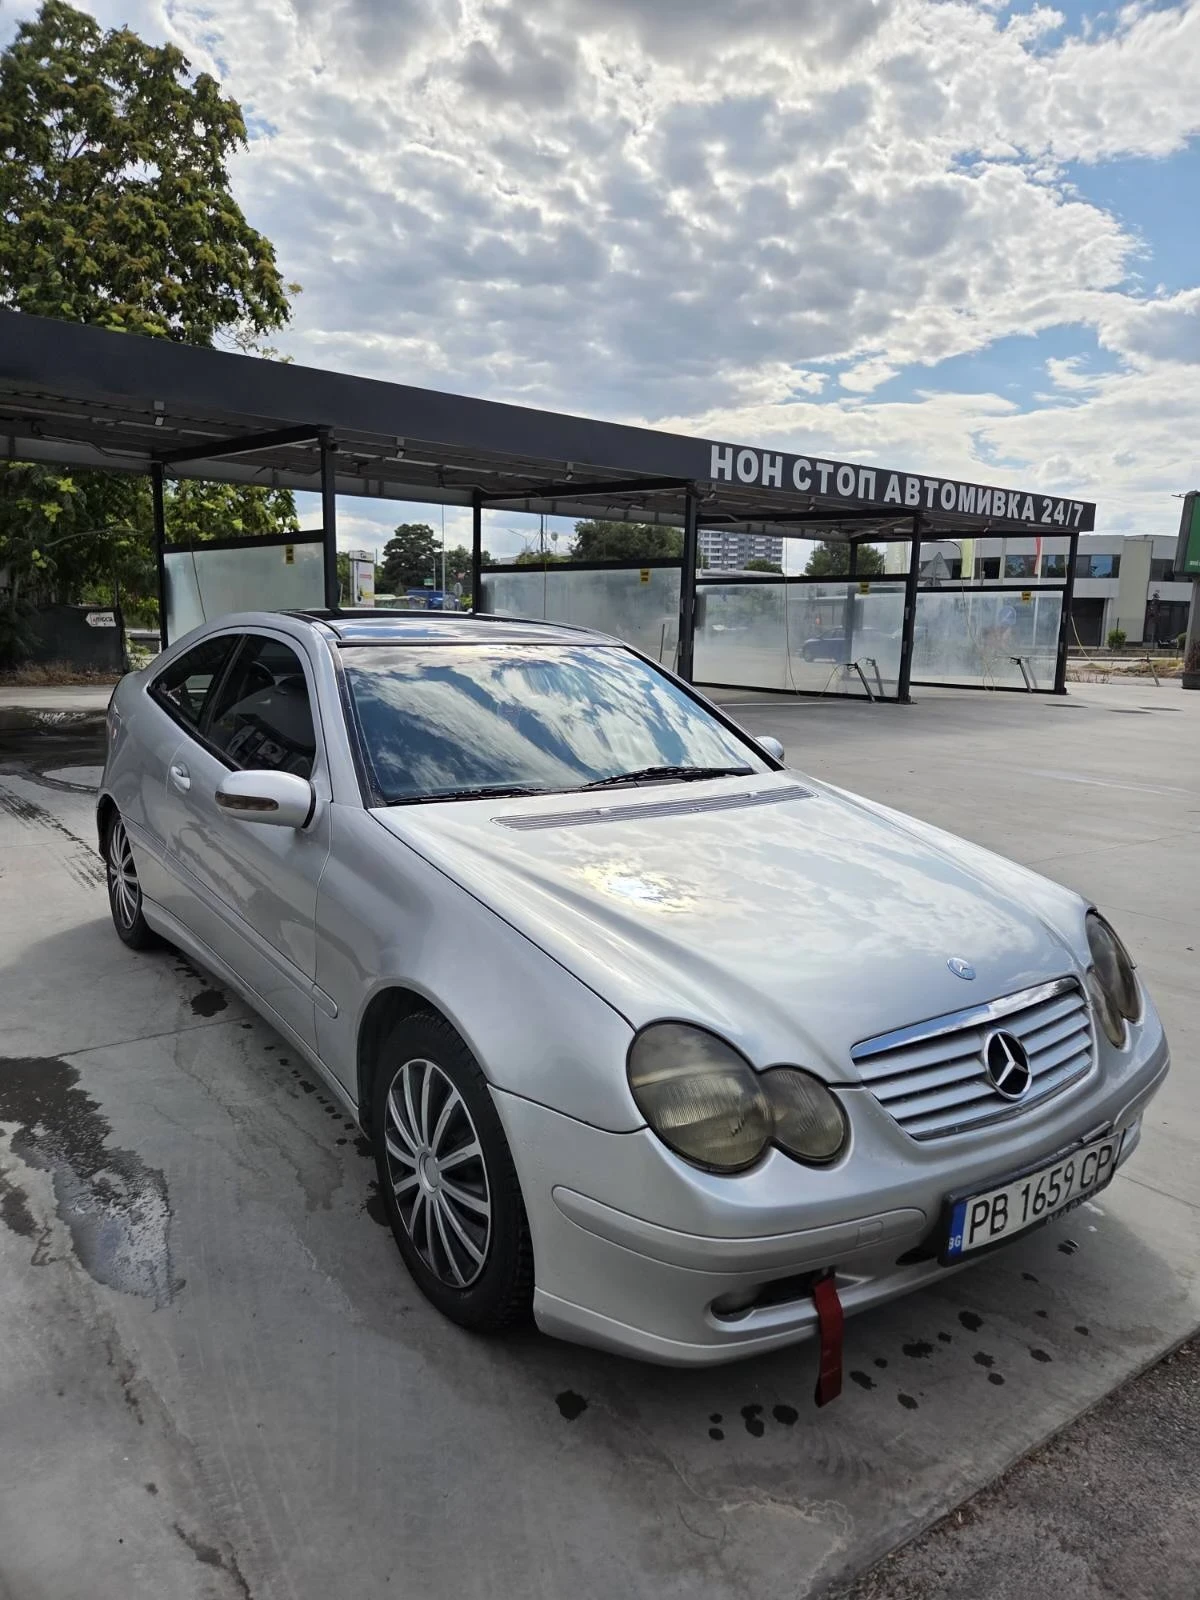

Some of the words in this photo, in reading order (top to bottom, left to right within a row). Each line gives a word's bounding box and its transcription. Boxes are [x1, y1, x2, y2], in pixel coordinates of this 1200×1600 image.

[709, 444, 783, 488] НОН
[792, 458, 877, 500] СТОП
[883, 473, 1035, 521] АВТОМИВКА
[1040, 501, 1084, 527] 24/7
[968, 1193, 1009, 1244] PB
[1020, 1161, 1075, 1222] 1659
[1080, 1145, 1113, 1188] CP
